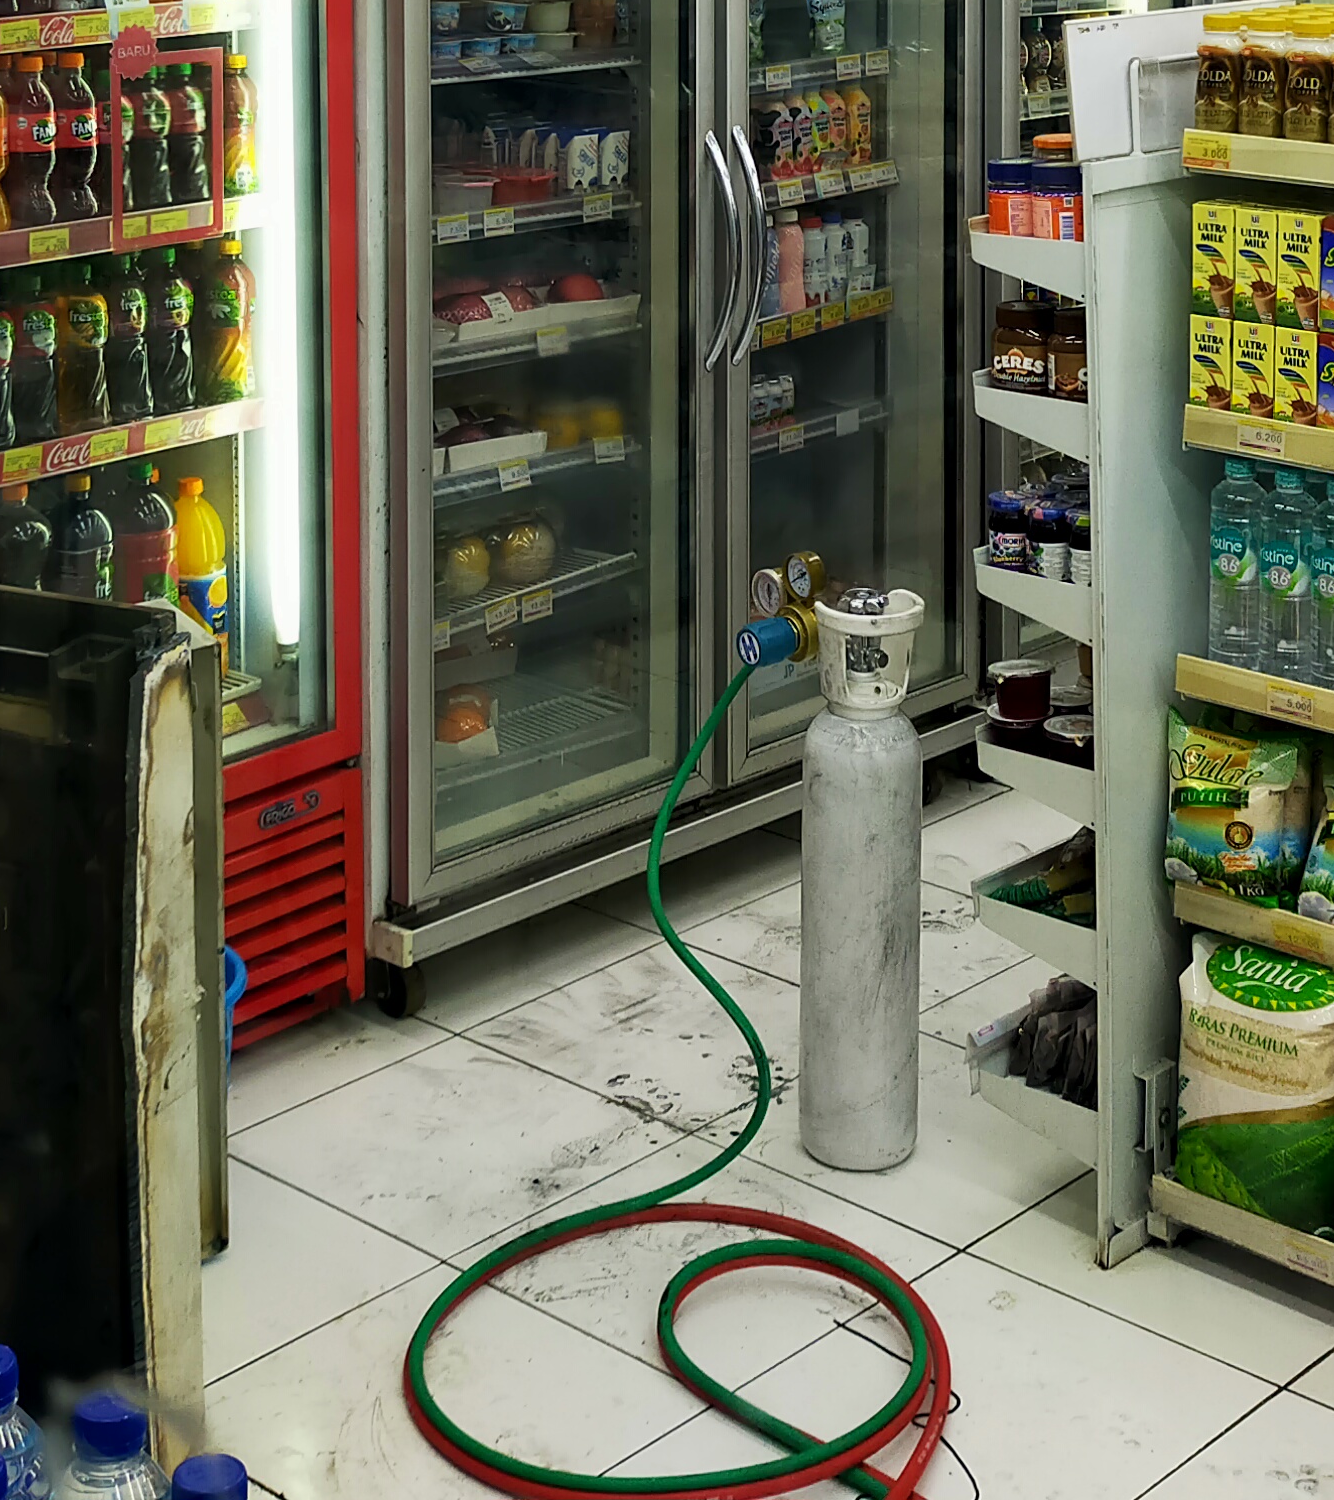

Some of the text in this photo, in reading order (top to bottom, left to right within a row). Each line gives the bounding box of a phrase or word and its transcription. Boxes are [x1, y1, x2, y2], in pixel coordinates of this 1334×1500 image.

[118, 45, 150, 59] BARU
[1202, 148, 1228, 160] 3.000
[1197, 223, 1227, 234] ULTRA
[1240, 228, 1270, 240] ULTRA
[1200, 232, 1224, 244] MILK
[1243, 238, 1267, 249] MILK
[1283, 233, 1313, 244] ULTRA
[1286, 243, 1310, 254] MILK
[1194, 333, 1224, 345] ULTRA
[1198, 343, 1222, 354] MILK
[1238, 340, 1268, 351] ULTRA
[1240, 350, 1265, 361] MILK
[1280, 347, 1310, 359] ULTRA
[993, 355, 1045, 374] CERES
[1283, 356, 1307, 368] MILK
[1255, 431, 1283, 444] 6.200
[1169, 742, 1263, 787] Gulare
[1179, 790, 1227, 804] PUTIH
[1221, 944, 1313, 994] Sania
[1229, 1022, 1299, 1058] PREMIUM
